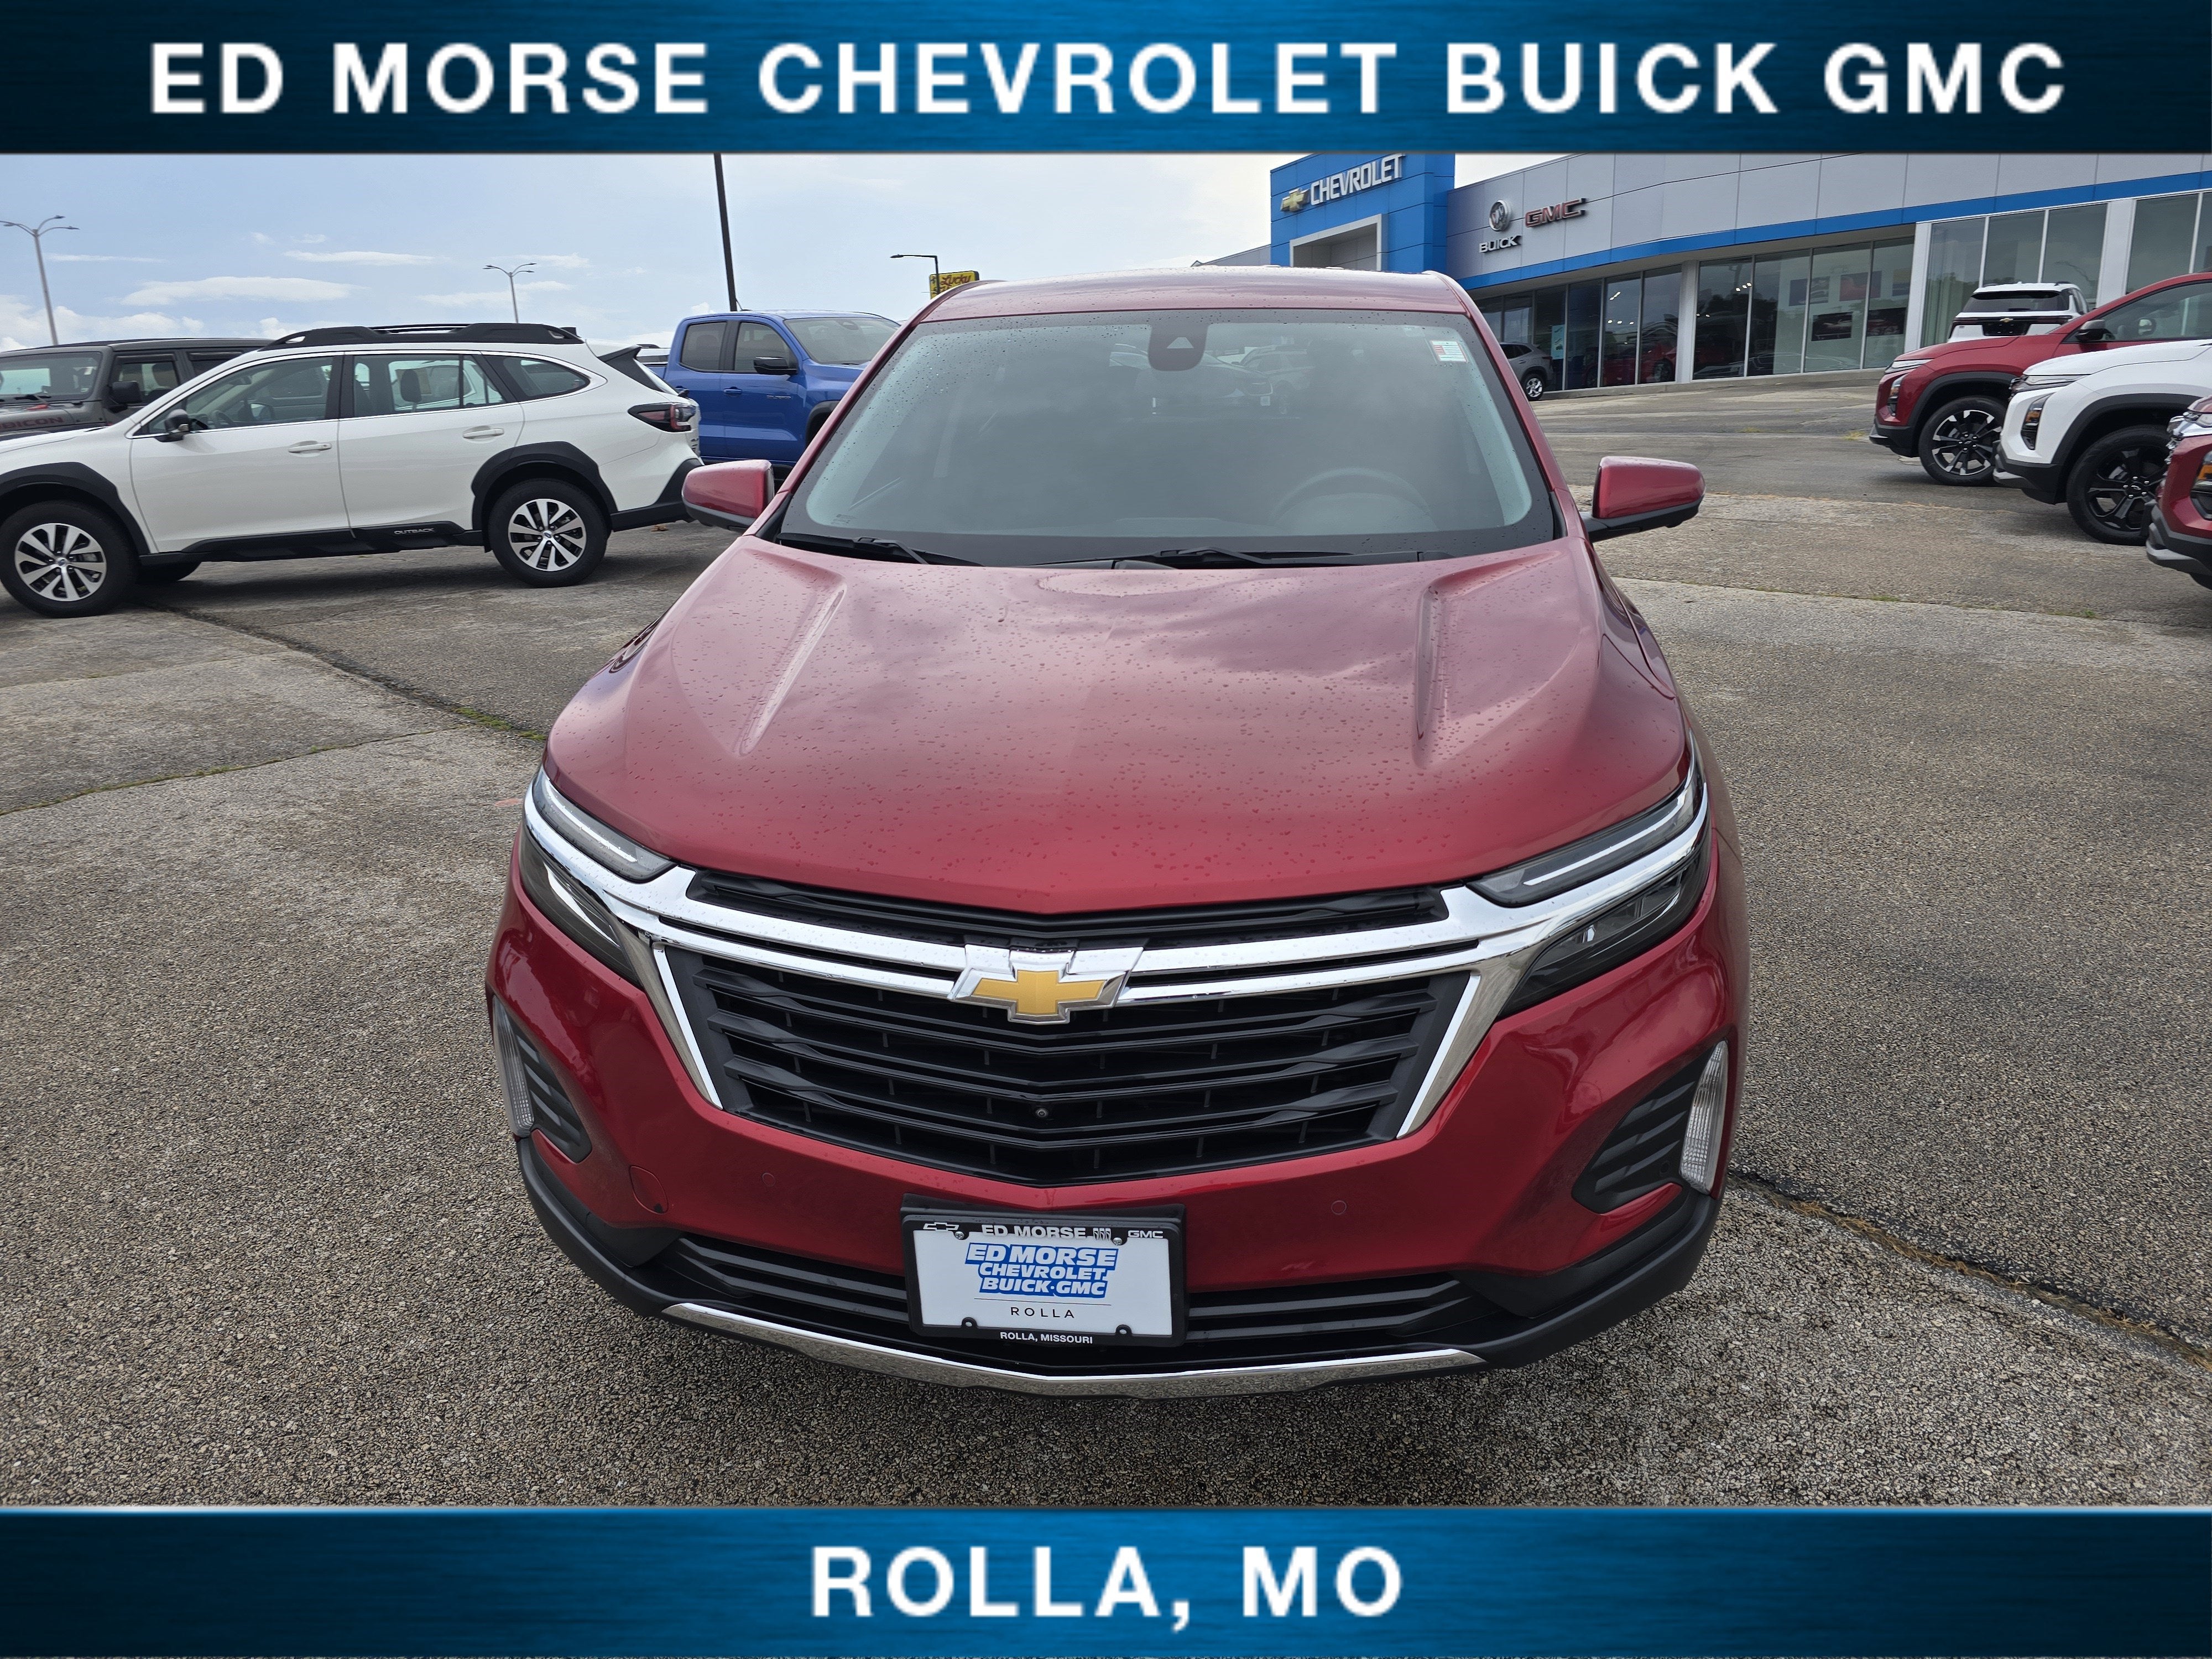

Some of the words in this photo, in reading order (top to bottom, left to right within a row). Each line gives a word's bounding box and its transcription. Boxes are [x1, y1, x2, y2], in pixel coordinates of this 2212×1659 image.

[1311, 153, 1405, 205] CHEVROLET
[1525, 199, 1586, 228] GMC
[1479, 236, 1519, 253] BUICK
[0, 417, 64, 429] BICON
[981, 1224, 1008, 1237] ED
[1014, 1225, 1086, 1239] MORSE
[1128, 1230, 1164, 1239] GMC
[967, 1244, 1007, 1262] ED
[1009, 1245, 1117, 1266] MORSE
[979, 1262, 1106, 1280] CHEVROLET
[1010, 1307, 1074, 1318] ROLLA
[1000, 1332, 1038, 1342] ROLLA,
[1040, 1333, 1093, 1344] MISSOURI
